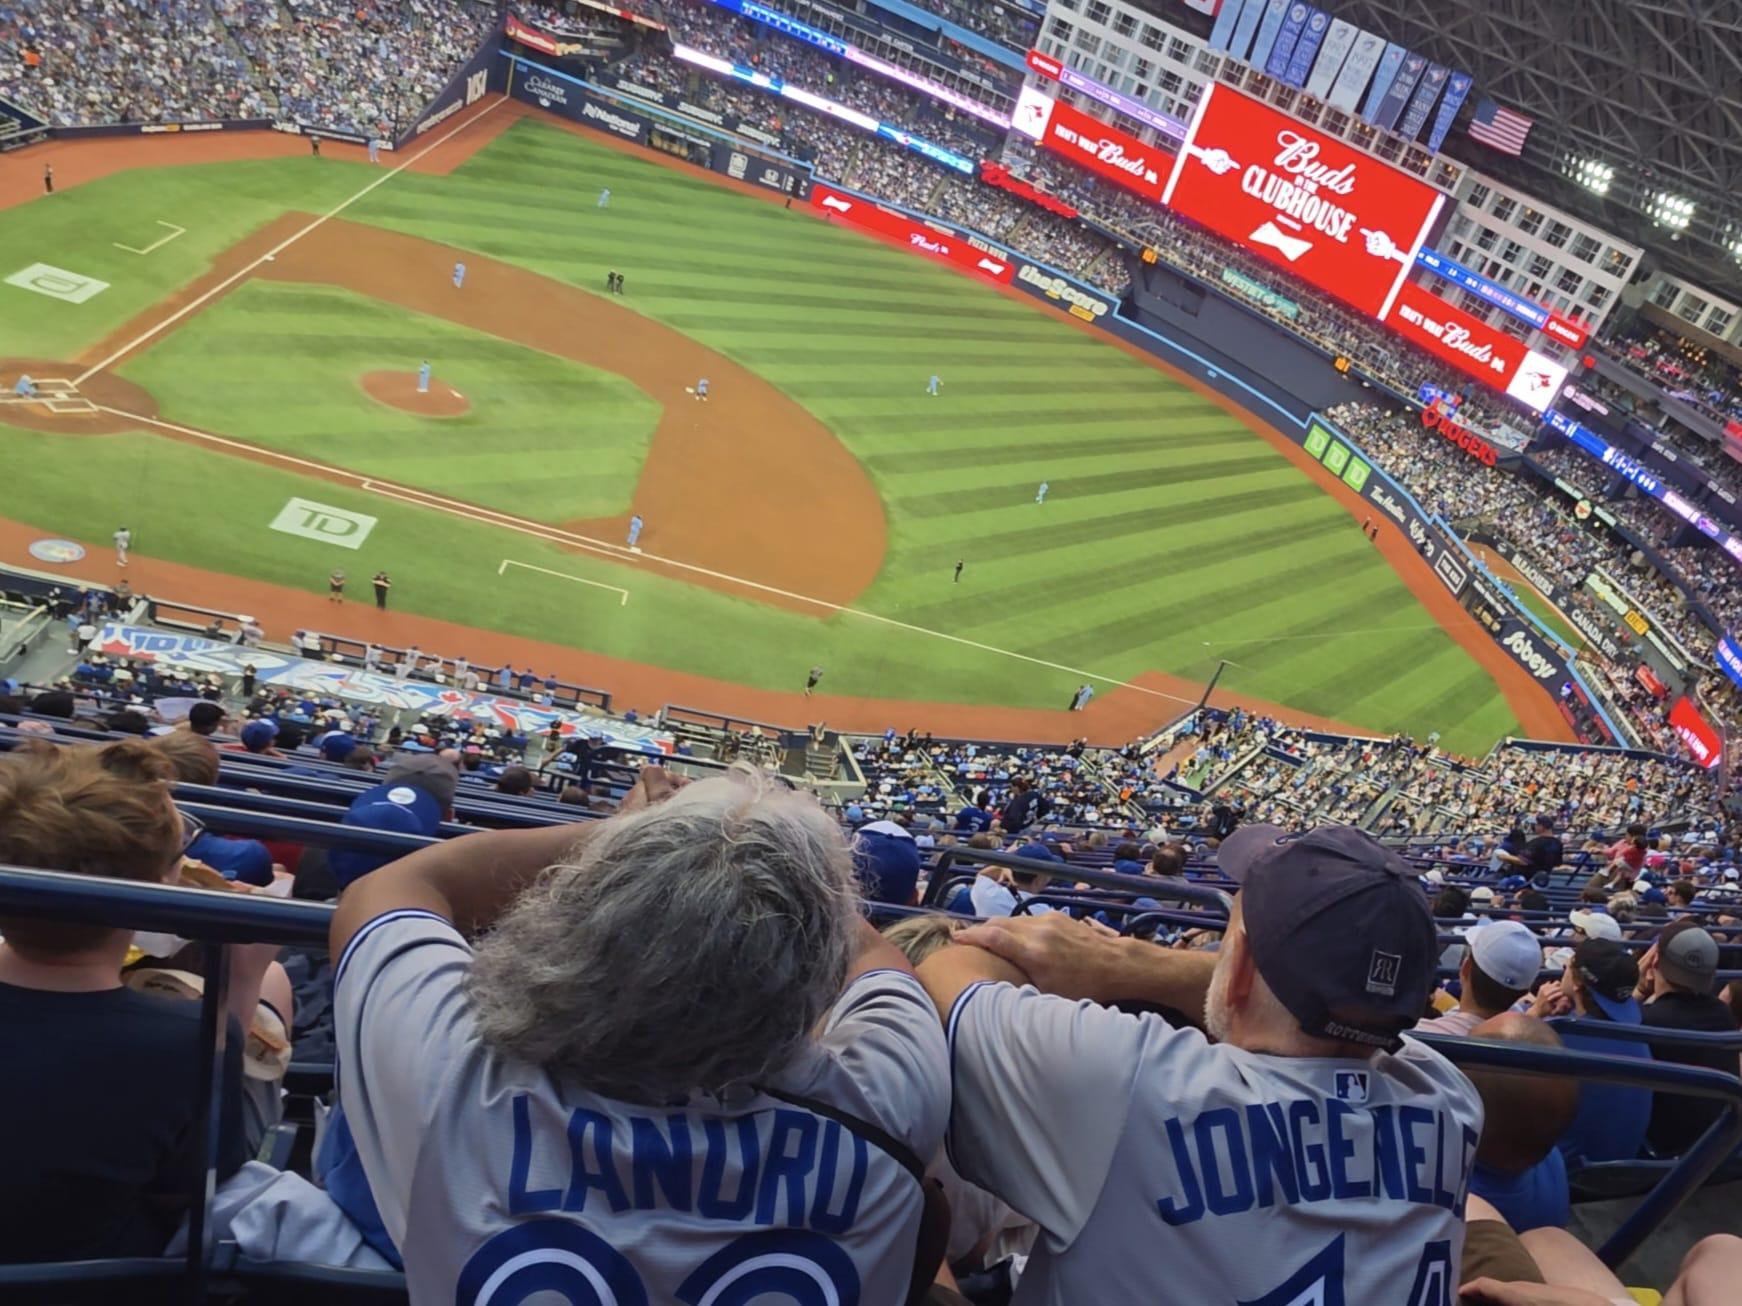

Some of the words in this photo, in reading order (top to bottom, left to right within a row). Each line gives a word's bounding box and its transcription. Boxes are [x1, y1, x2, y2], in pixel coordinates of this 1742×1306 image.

[1098, 140, 1144, 175] Buds
[1274, 130, 1356, 194] Buds
[1242, 165, 1356, 242] CLUBHOUSE
[1018, 265, 1108, 317] theScore
[1442, 322, 1493, 363] Buds
[1437, 418, 1499, 466] ROGERS
[298, 506, 359, 536] TD
[1571, 609, 1601, 645] CANADA
[1504, 631, 1557, 679] Sobeys
